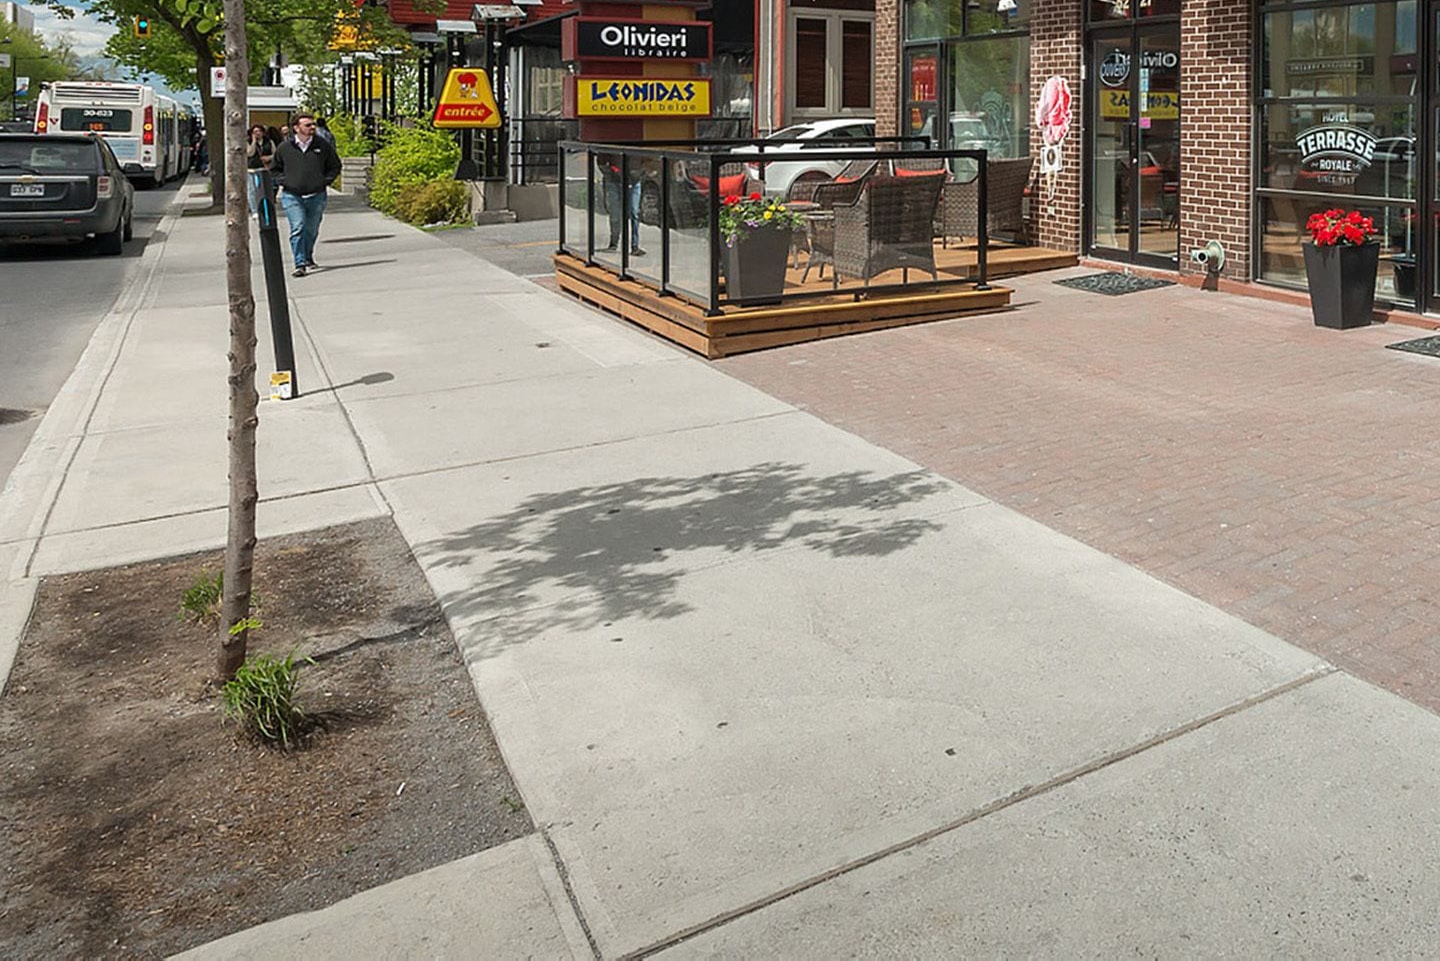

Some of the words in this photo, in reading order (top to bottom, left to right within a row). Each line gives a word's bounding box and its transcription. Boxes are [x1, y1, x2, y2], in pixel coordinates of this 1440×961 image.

[600, 25, 687, 47] Olivieri
[591, 82, 696, 102] LEONIDAS
[444, 106, 486, 117] entrée
[592, 103, 653, 111] chocolat
[659, 103, 697, 112] belge
[1297, 131, 1376, 160] TERRASSE
[1320, 159, 1352, 170] ROYALE
